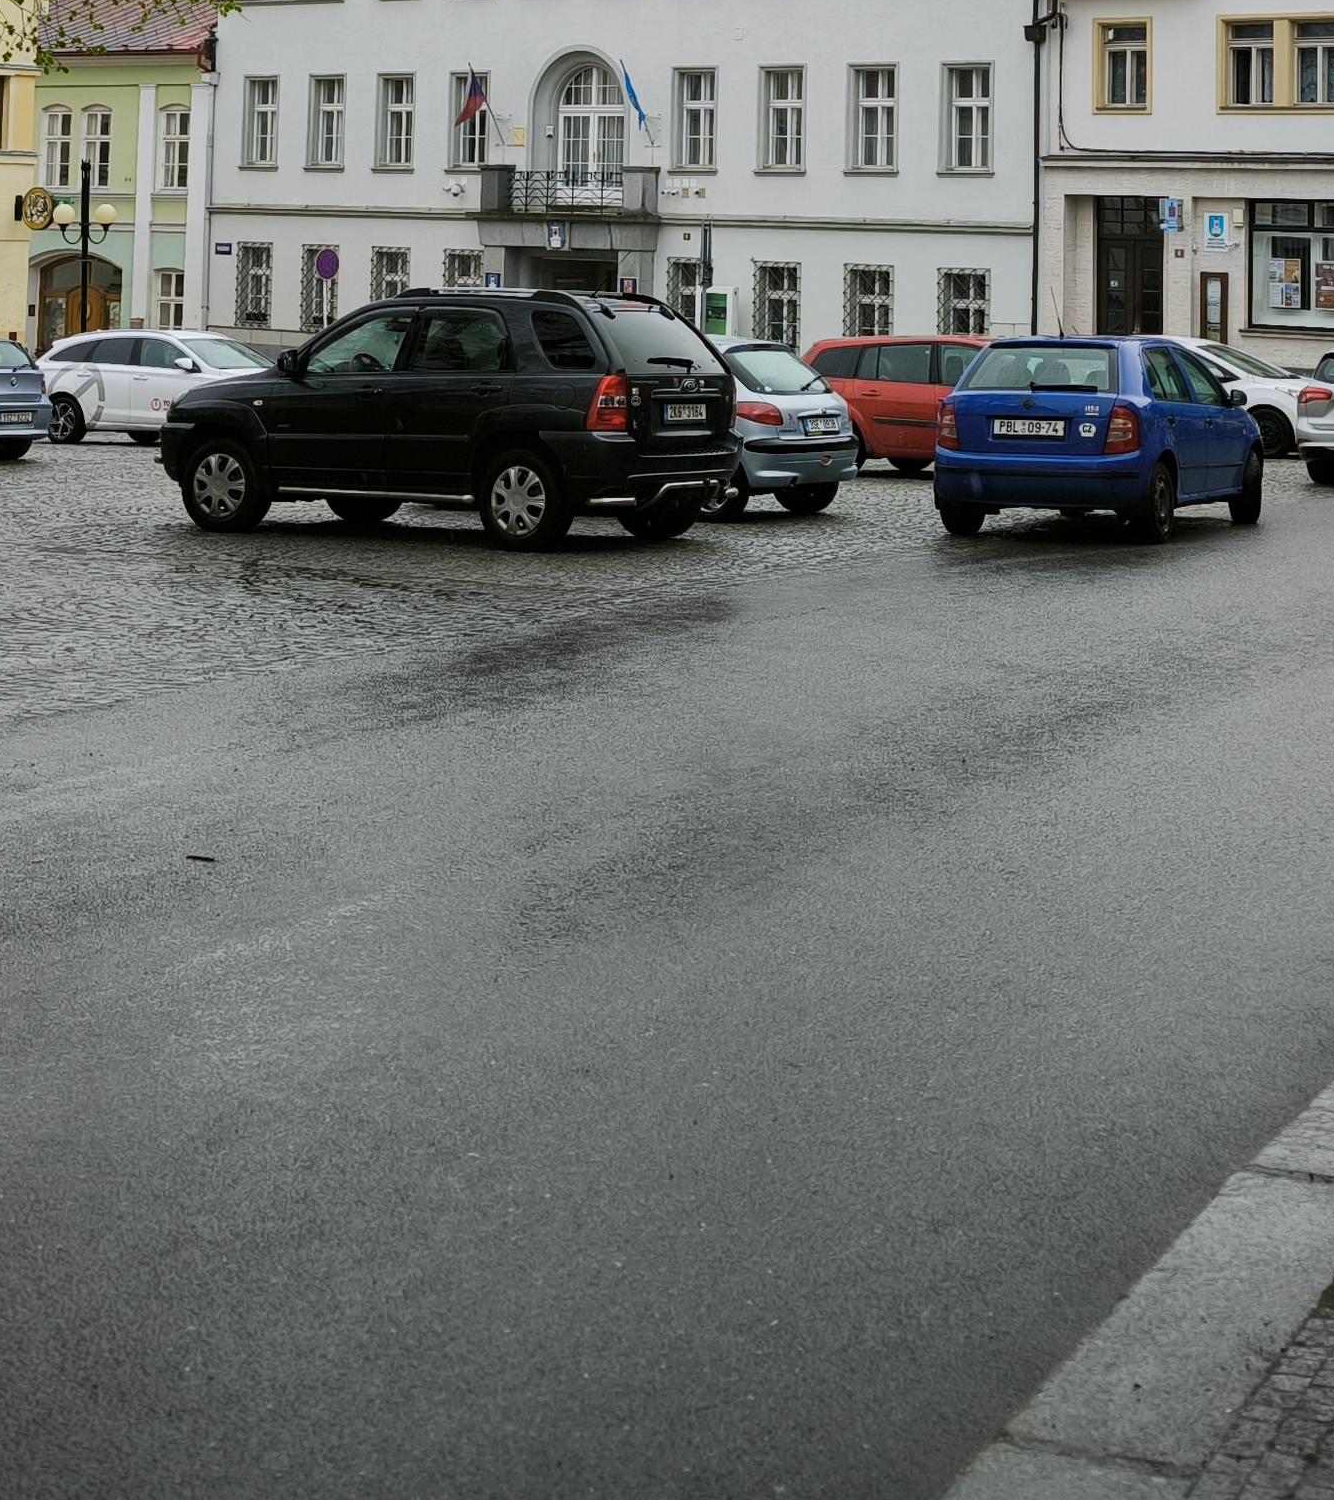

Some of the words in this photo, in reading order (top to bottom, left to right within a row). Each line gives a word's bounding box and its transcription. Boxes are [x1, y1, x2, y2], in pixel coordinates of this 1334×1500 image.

[999, 421, 1019, 433] PBL
[1027, 422, 1059, 434] 09-74
[1082, 424, 1093, 434] CZ
